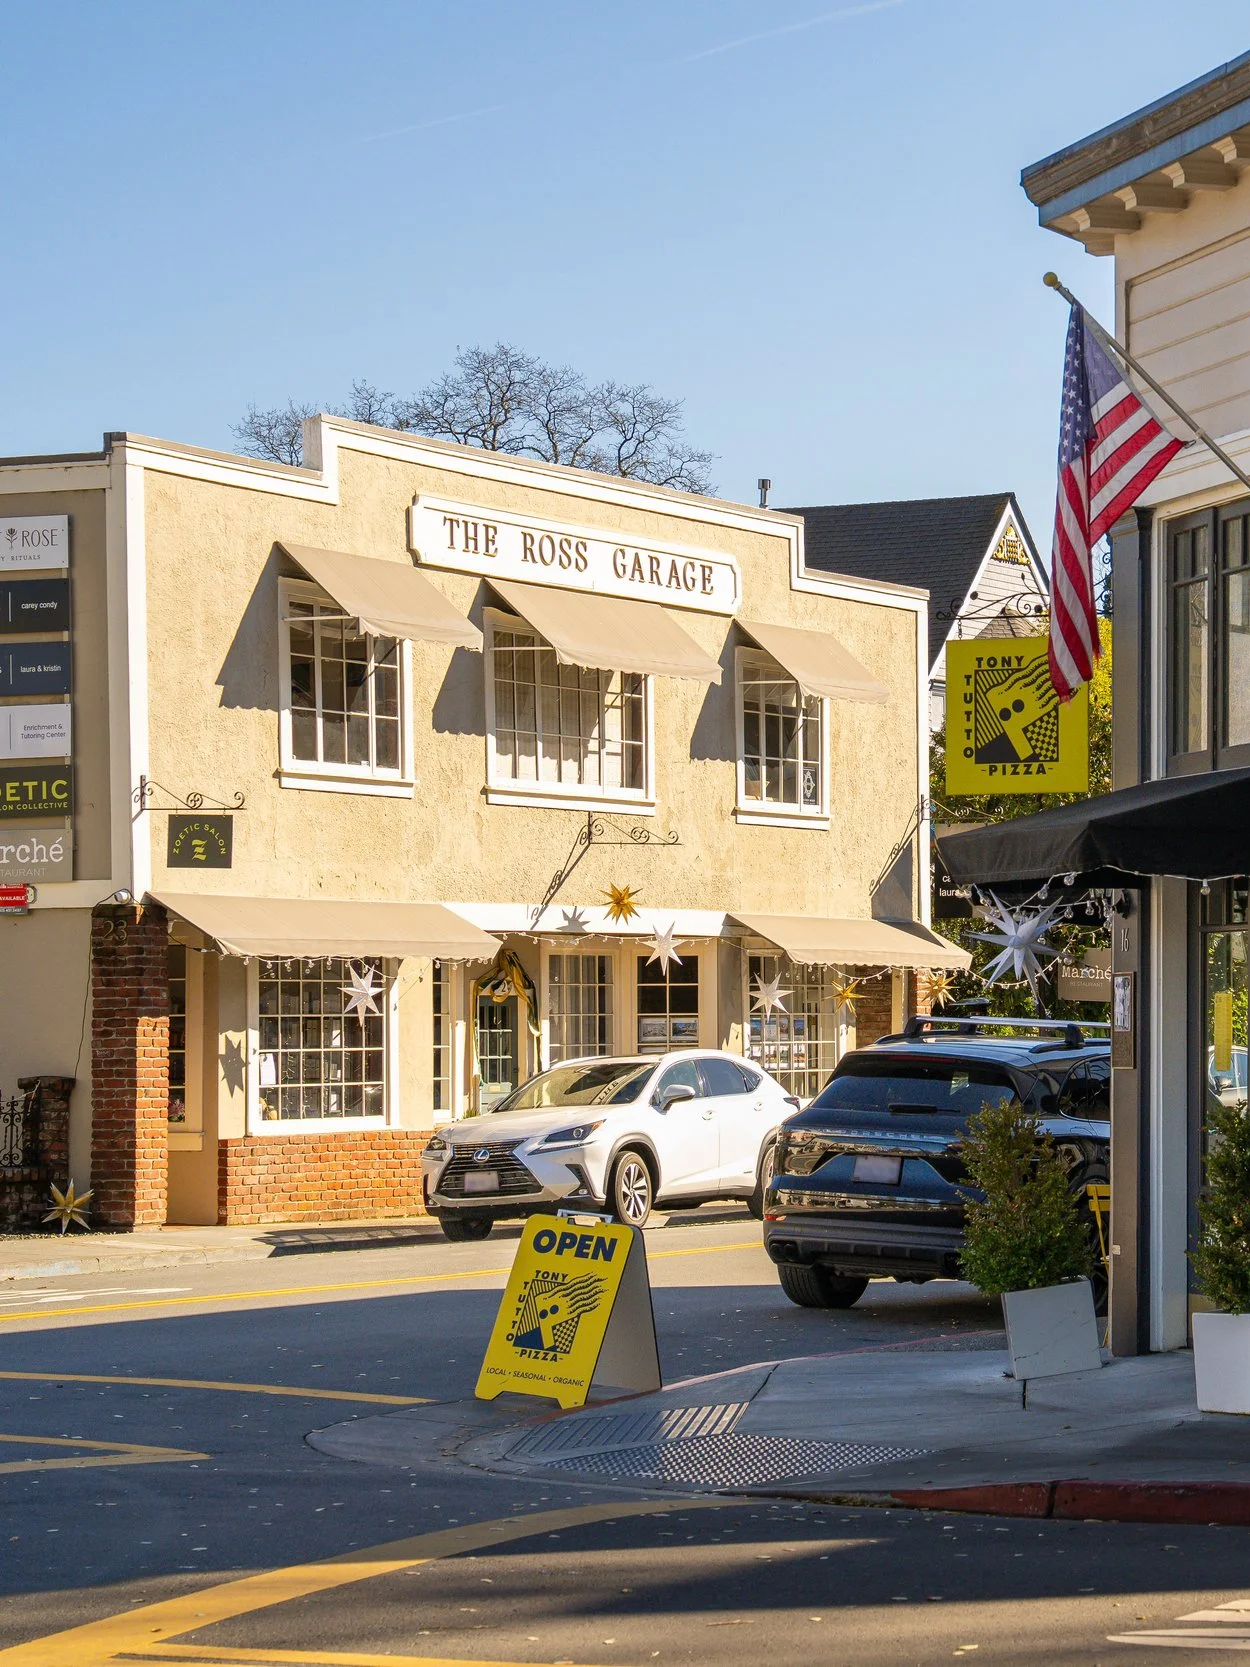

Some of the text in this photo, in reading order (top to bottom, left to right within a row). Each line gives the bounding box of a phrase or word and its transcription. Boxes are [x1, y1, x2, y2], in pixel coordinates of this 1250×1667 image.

[21, 528, 58, 548] ROSE
[443, 515, 714, 595] THE ROSS GARAGE
[21, 601, 58, 610] carey condy
[20, 664, 61, 673] laura & kristin
[975, 656, 1025, 669] TONY
[963, 674, 974, 758] TUTTO
[23, 723, 57, 731] Enrichment
[21, 732, 45, 740] Tutoring
[988, 763, 1047, 776] PIZZA
[0, 779, 68, 802] ETIC
[16, 801, 68, 810] COLLECTIVE
[203, 823, 227, 855] SALON
[0, 836, 64, 863] rché
[532, 1228, 618, 1263] OPEN
[535, 1269, 569, 1282] TONY
[506, 1281, 530, 1342] TUTTO
[519, 1349, 558, 1363] PIZZA
[486, 1367, 585, 1387] LOCAL SEASONAL ORGANIC
